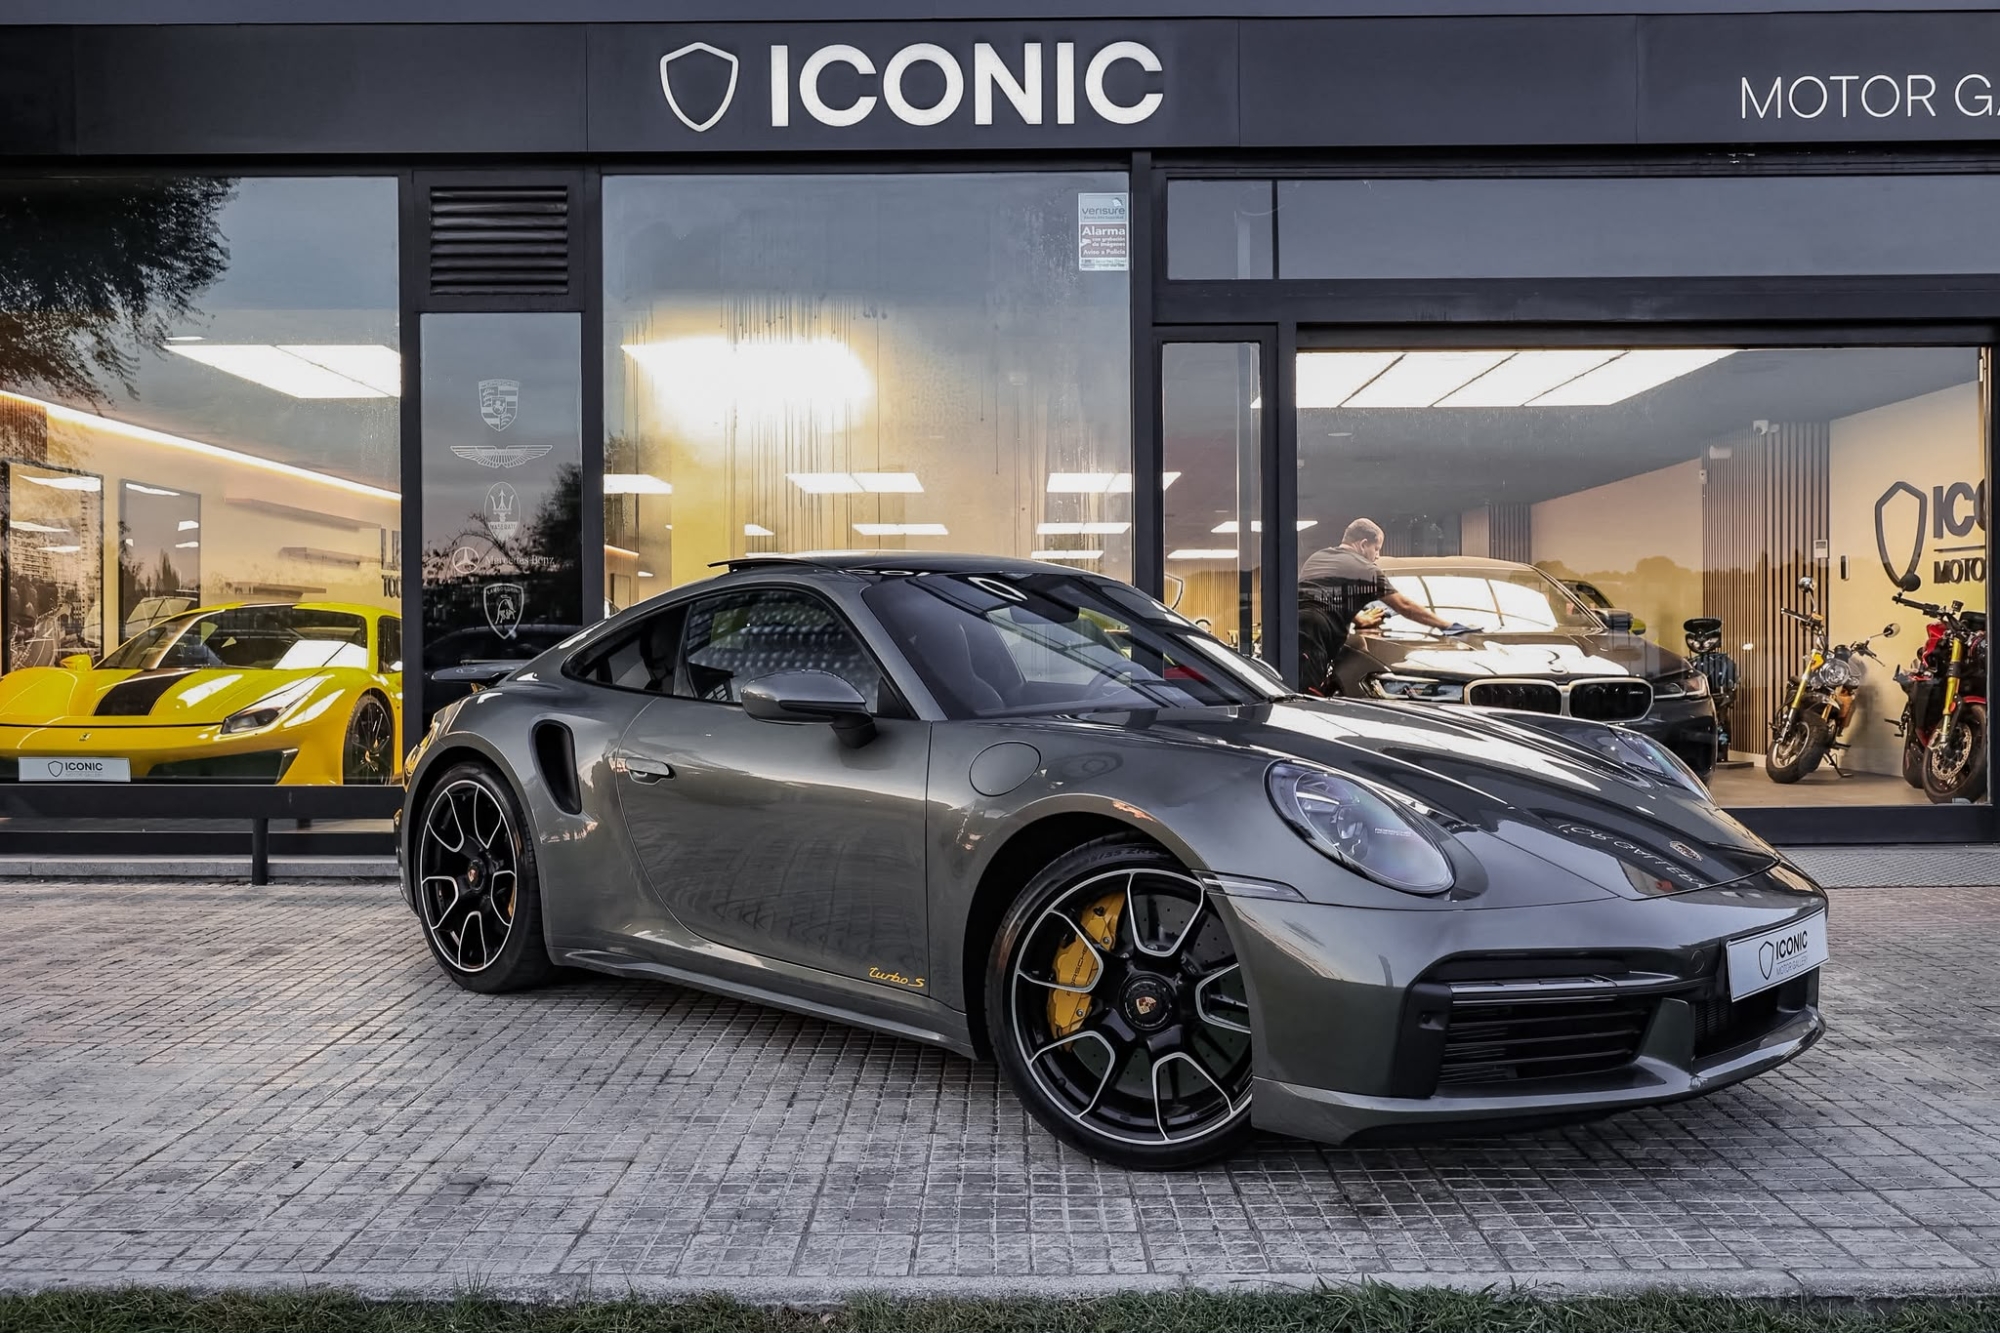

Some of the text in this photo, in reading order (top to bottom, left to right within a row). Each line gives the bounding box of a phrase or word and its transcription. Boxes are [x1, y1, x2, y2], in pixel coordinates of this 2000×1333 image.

[770, 41, 1164, 127] ICONIC
[1741, 73, 2000, 119] MOTOR G
[1082, 207, 1125, 215] verisure
[1082, 226, 1126, 236] Alarma
[65, 762, 103, 771] ICONIC
[1776, 930, 1808, 960] ICONIC
